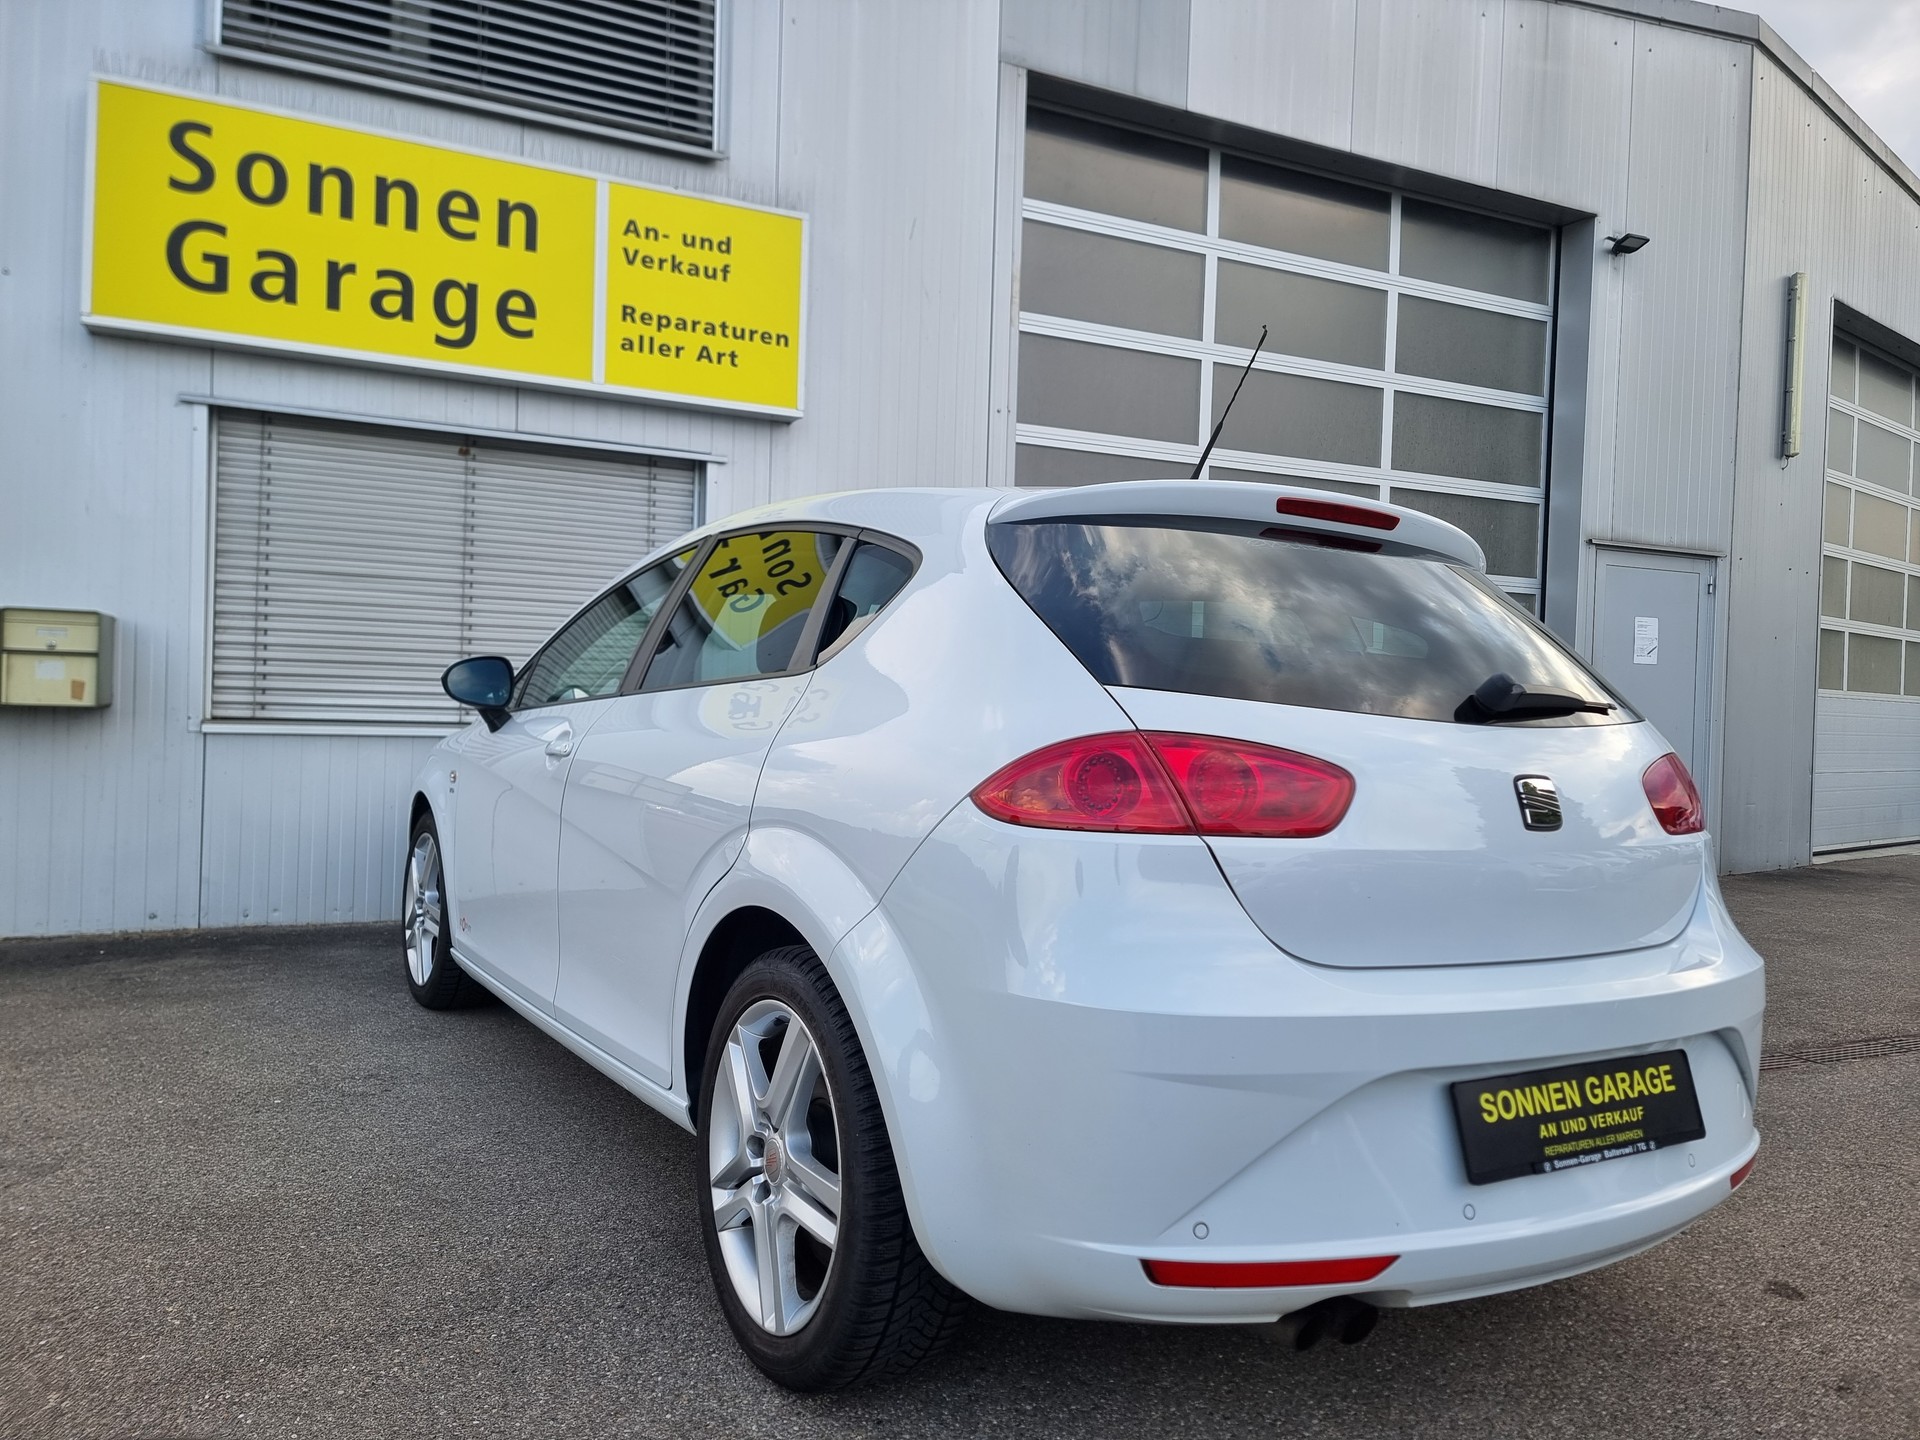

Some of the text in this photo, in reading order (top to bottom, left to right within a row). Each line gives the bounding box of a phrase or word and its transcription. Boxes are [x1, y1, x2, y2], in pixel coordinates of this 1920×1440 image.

[167, 120, 540, 254] Sonnen
[622, 219, 732, 255] An- und
[622, 247, 731, 282] Verkauf
[164, 219, 539, 350] Garage
[621, 304, 789, 348] Reparaturen
[620, 334, 739, 368] aller Art
[1479, 1064, 1676, 1123] SONNEN GARAGE
[1539, 1106, 1644, 1139] AN UND VERKAUF
[1544, 1129, 1644, 1157] REPARATUREN ALLER MARKEN
[1554, 1153, 1602, 1169] Sonnen-Garage
